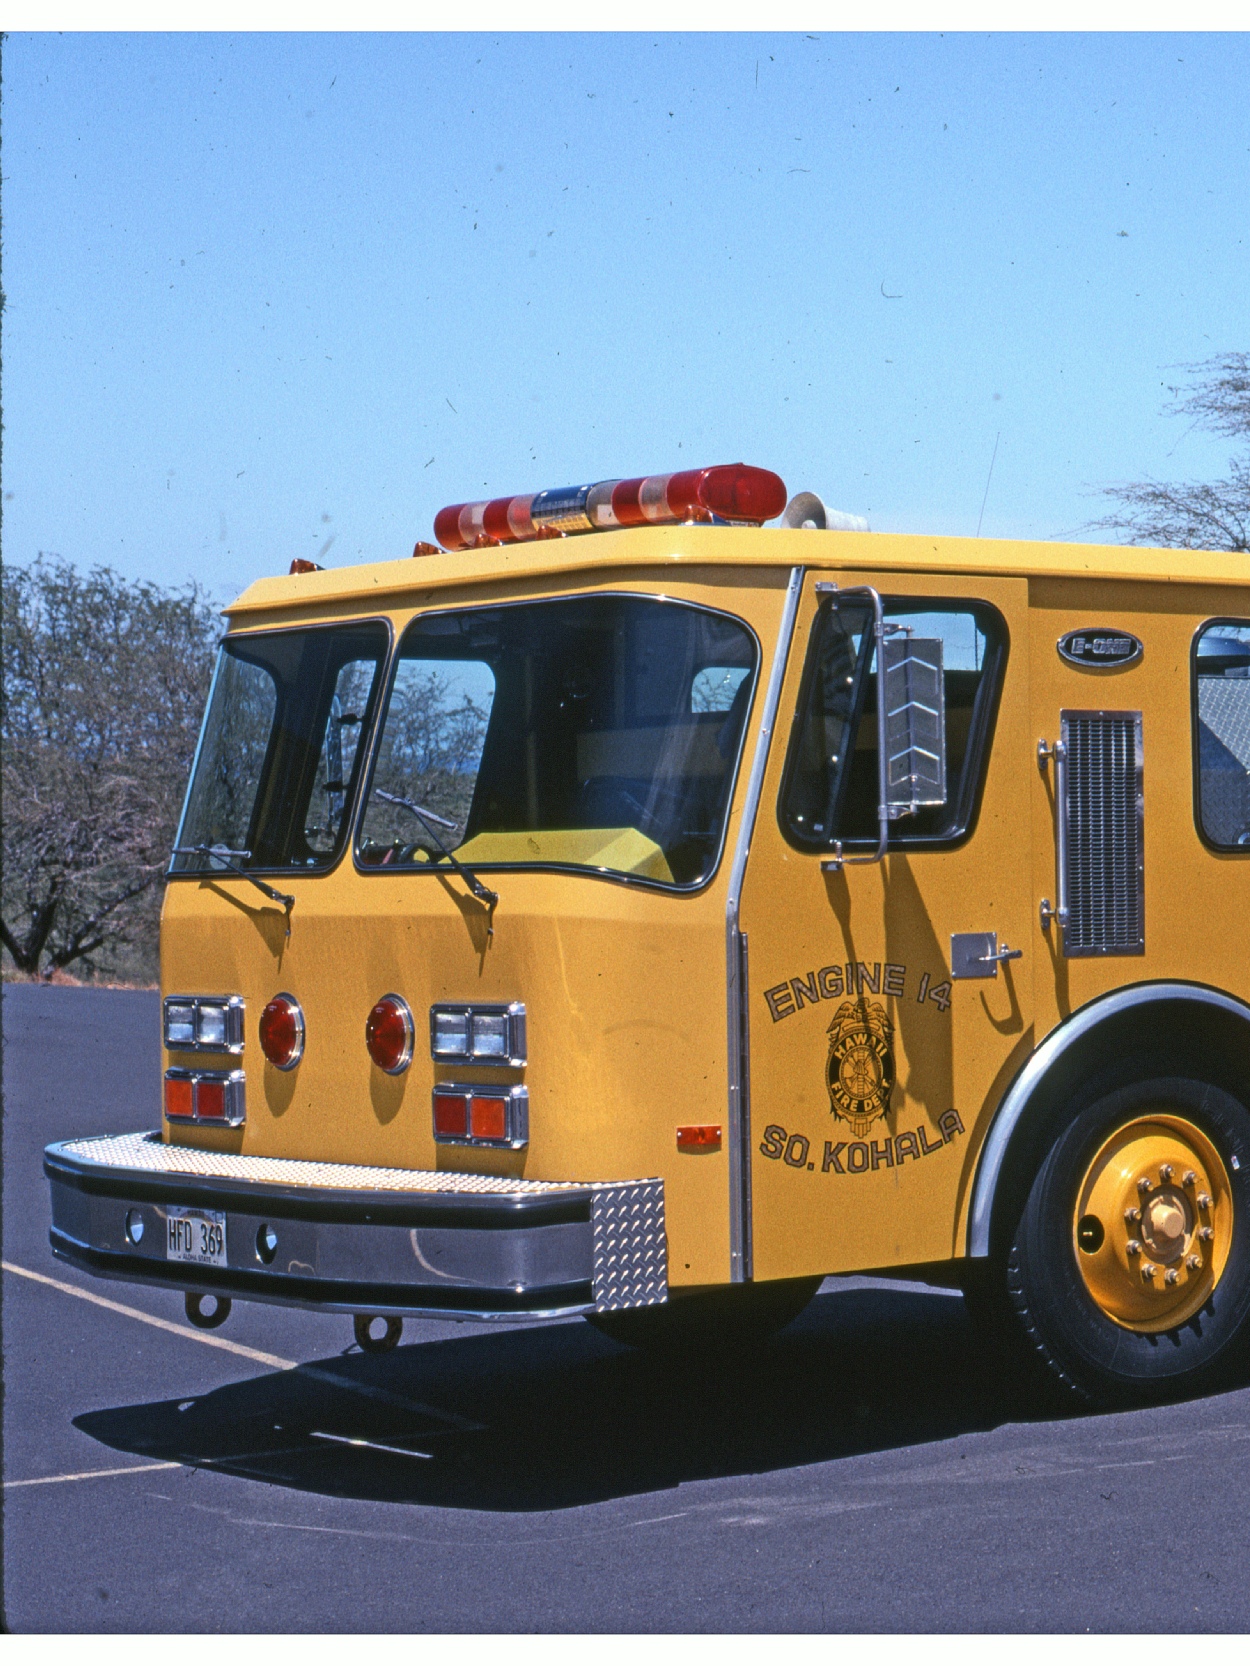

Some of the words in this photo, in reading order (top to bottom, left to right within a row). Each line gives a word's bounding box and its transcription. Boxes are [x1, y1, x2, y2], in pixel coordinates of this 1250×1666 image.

[1071, 637, 1132, 654] E-ONE
[763, 962, 906, 1024] ENGINE
[917, 972, 953, 1013] 14
[834, 1033, 888, 1060] HAWAII
[831, 1081, 858, 1112] FIRE
[759, 1124, 815, 1171] SO.
[821, 1109, 966, 1174] KOHALA
[168, 1218, 193, 1252] HFD
[200, 1222, 223, 1256] 369
